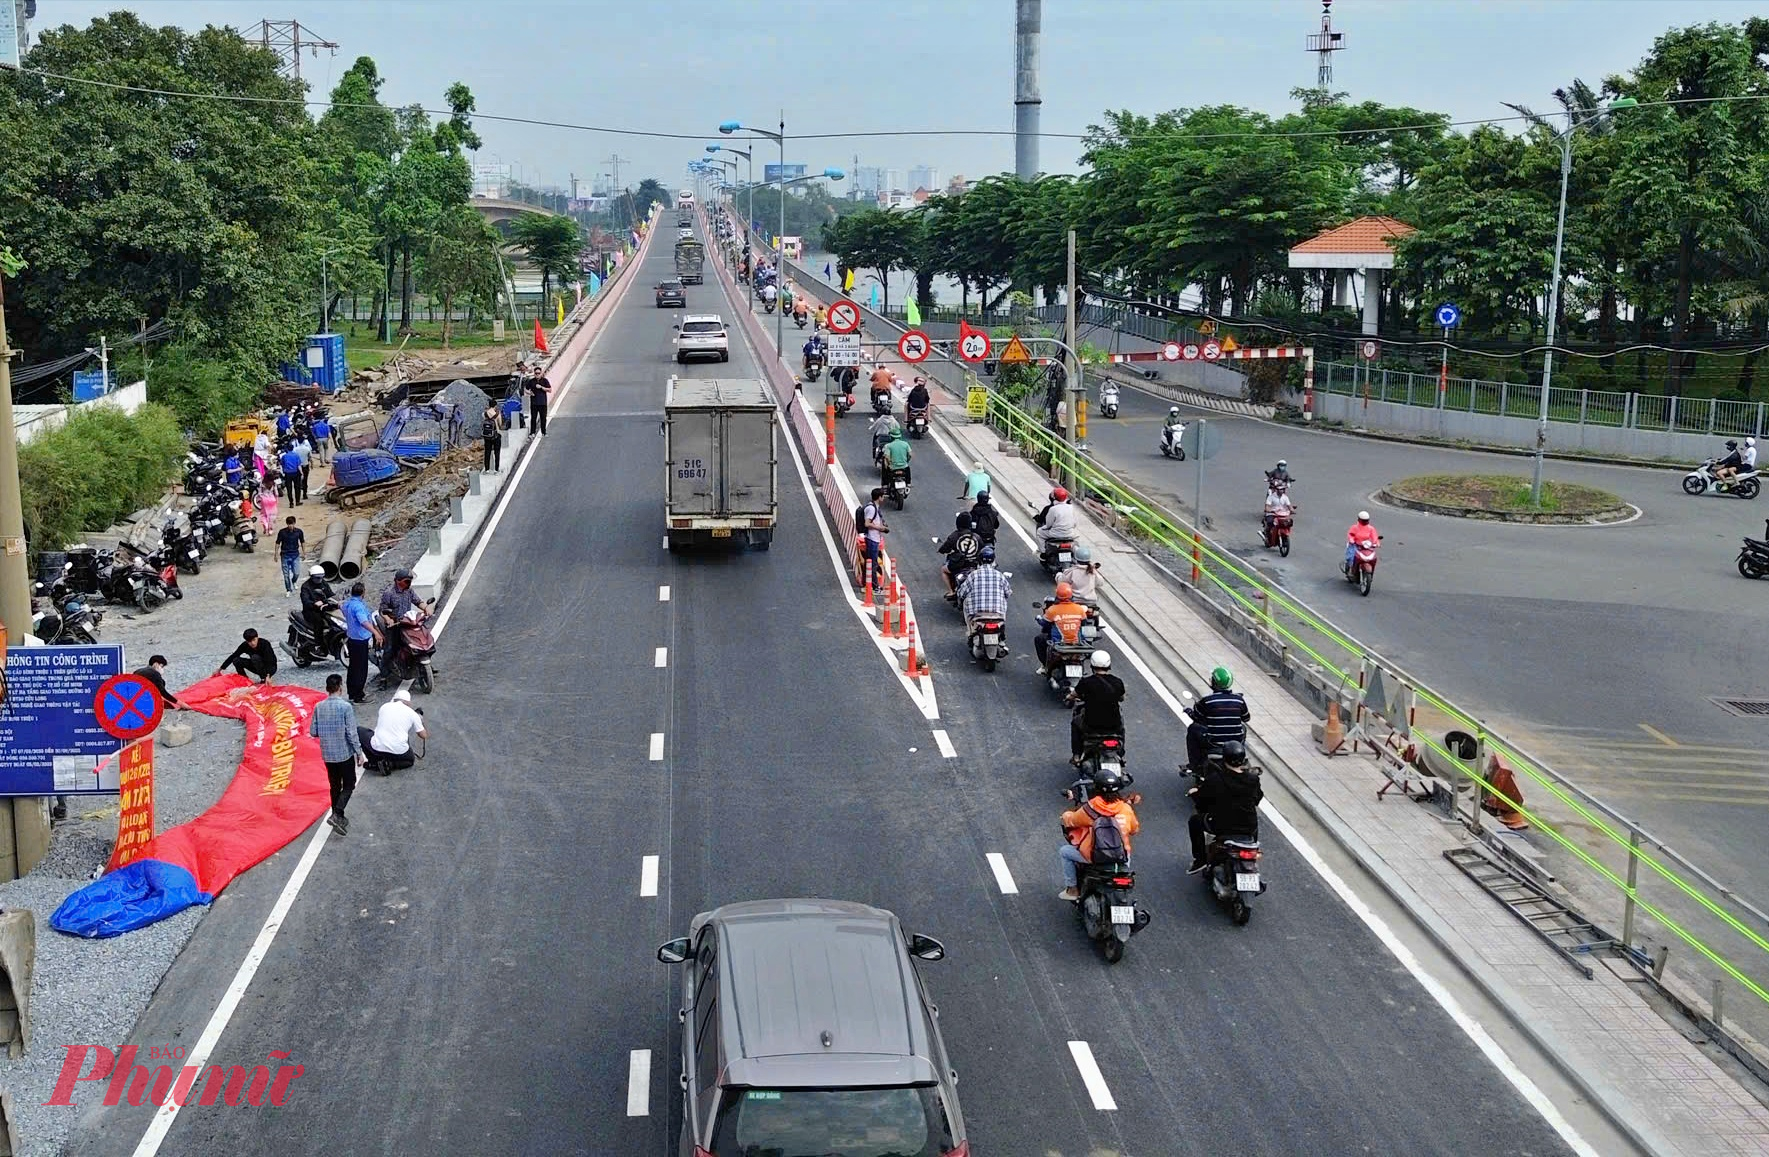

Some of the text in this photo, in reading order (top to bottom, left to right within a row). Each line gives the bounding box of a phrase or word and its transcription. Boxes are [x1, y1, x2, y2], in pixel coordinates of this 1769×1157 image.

[684, 459, 702, 468] 51C
[35, 655, 51, 666] TIN
[53, 653, 77, 665] CÔNG
[80, 652, 109, 665] TRÌNH
